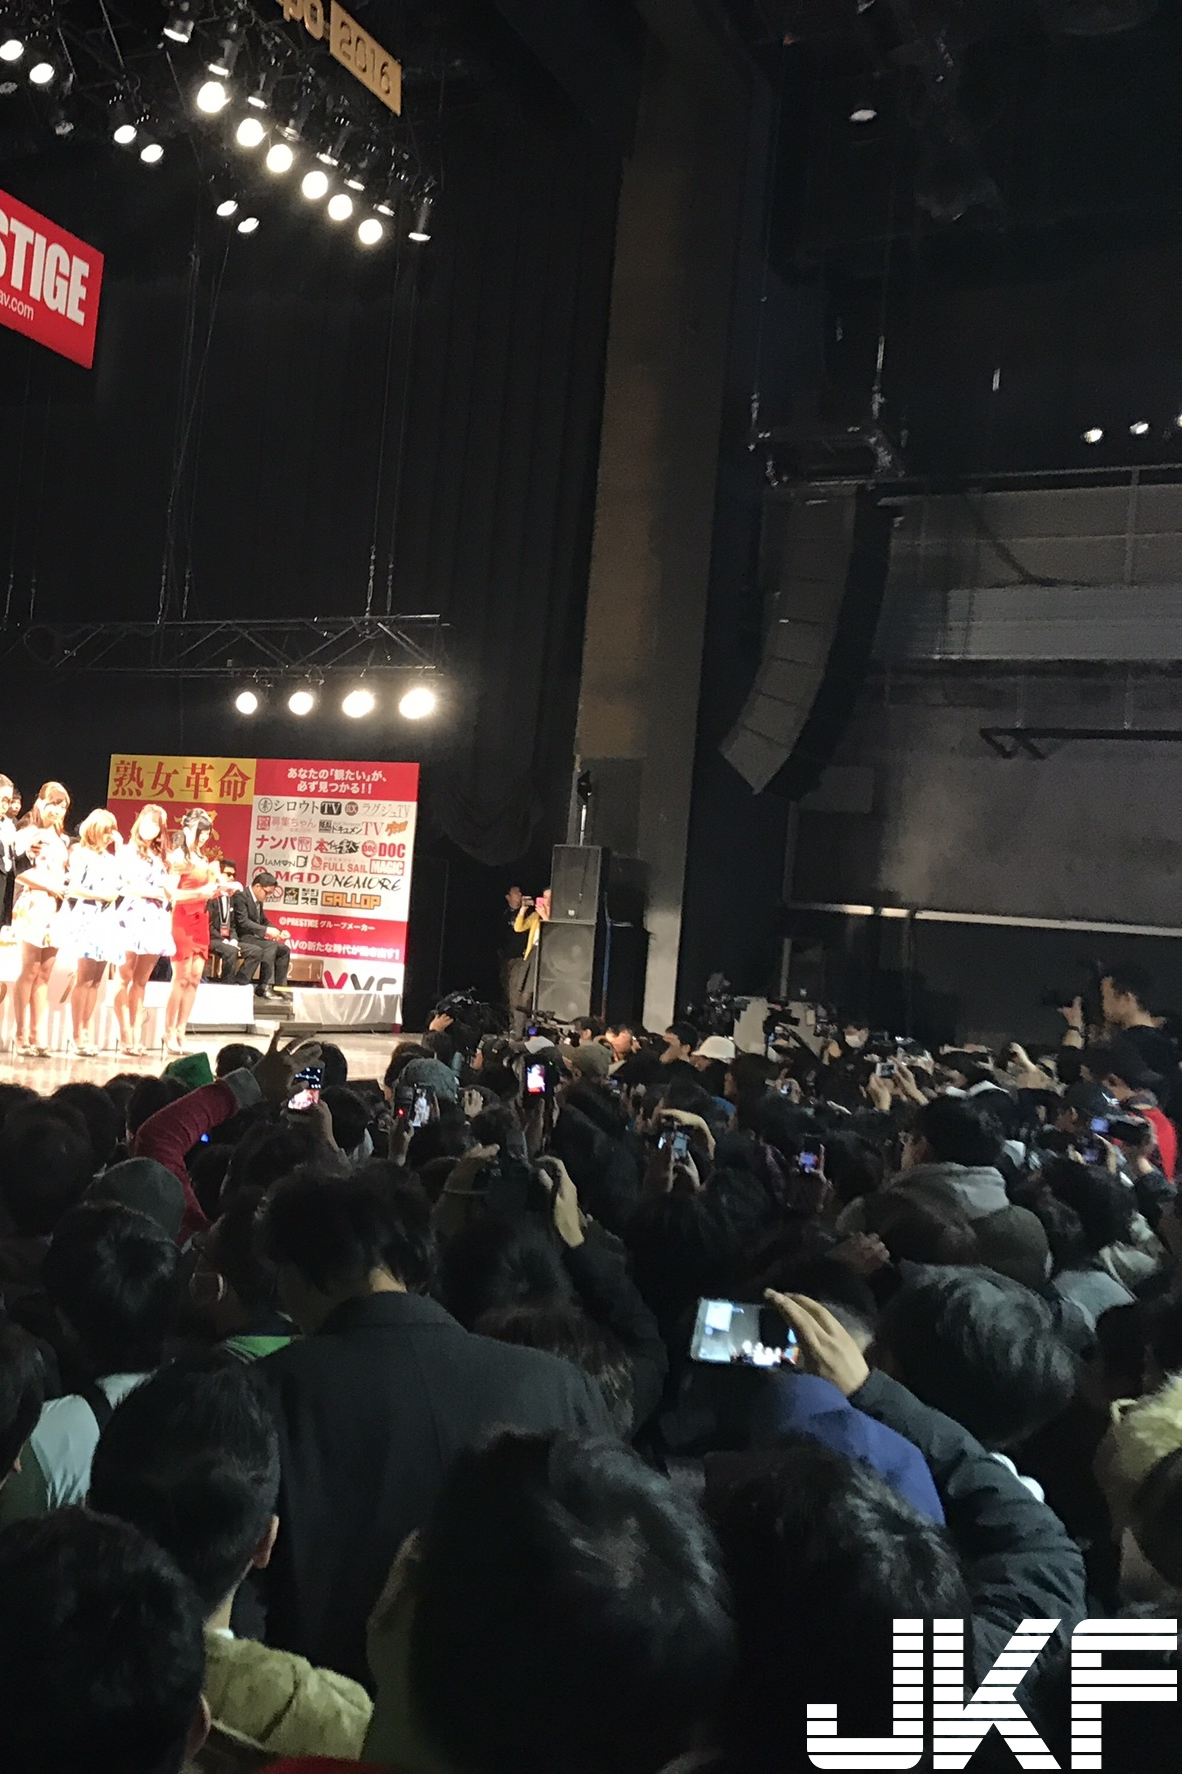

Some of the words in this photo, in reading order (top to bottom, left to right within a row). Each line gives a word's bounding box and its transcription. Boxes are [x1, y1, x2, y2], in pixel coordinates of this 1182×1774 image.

[339, 20, 391, 95] 2016
[112, 760, 252, 802] 熟女革命
[379, 843, 406, 858] DOC
[323, 862, 345, 873] FULL
[347, 863, 368, 874] SAIL
[275, 871, 320, 884] MAD
[321, 891, 381, 910] GALLOP
[286, 917, 318, 928] PRESTIGE
